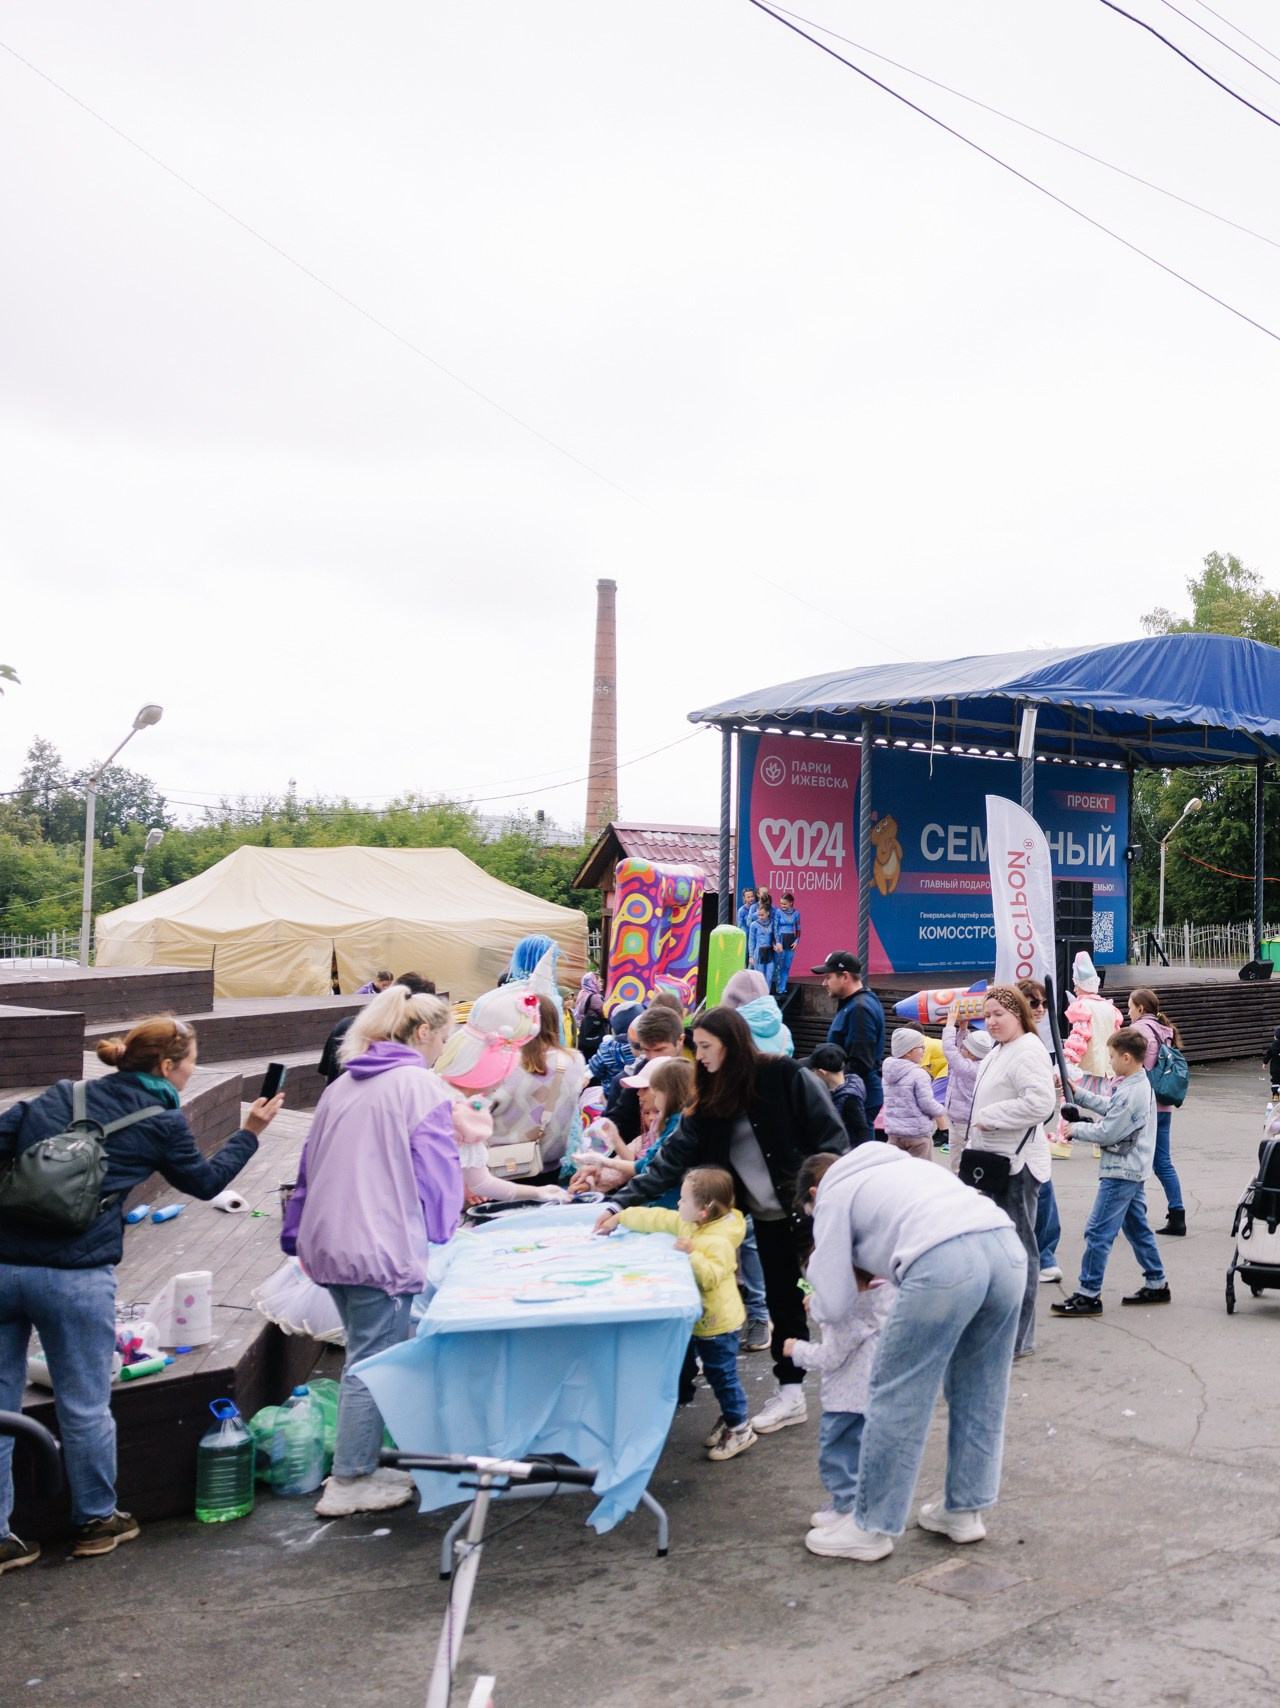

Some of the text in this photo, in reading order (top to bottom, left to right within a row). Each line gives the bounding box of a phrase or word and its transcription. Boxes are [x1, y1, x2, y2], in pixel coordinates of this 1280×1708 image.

[791, 760, 831, 775] ПАРКИ
[791, 774, 849, 789] ИЖЕВСКА
[1067, 794, 1110, 810] ПРОЕКТ
[758, 817, 846, 868] 2024
[920, 823, 1116, 867] СЕМНЫЙ
[769, 870, 795, 893] ГОД
[920, 879, 1115, 893] ГЛАВНЫЙ ПОДАРО ЕМЬЮ!
[920, 912, 957, 920] Генеральный
[958, 912, 979, 920] партнёр
[919, 925, 996, 939] КОМОССТРО
